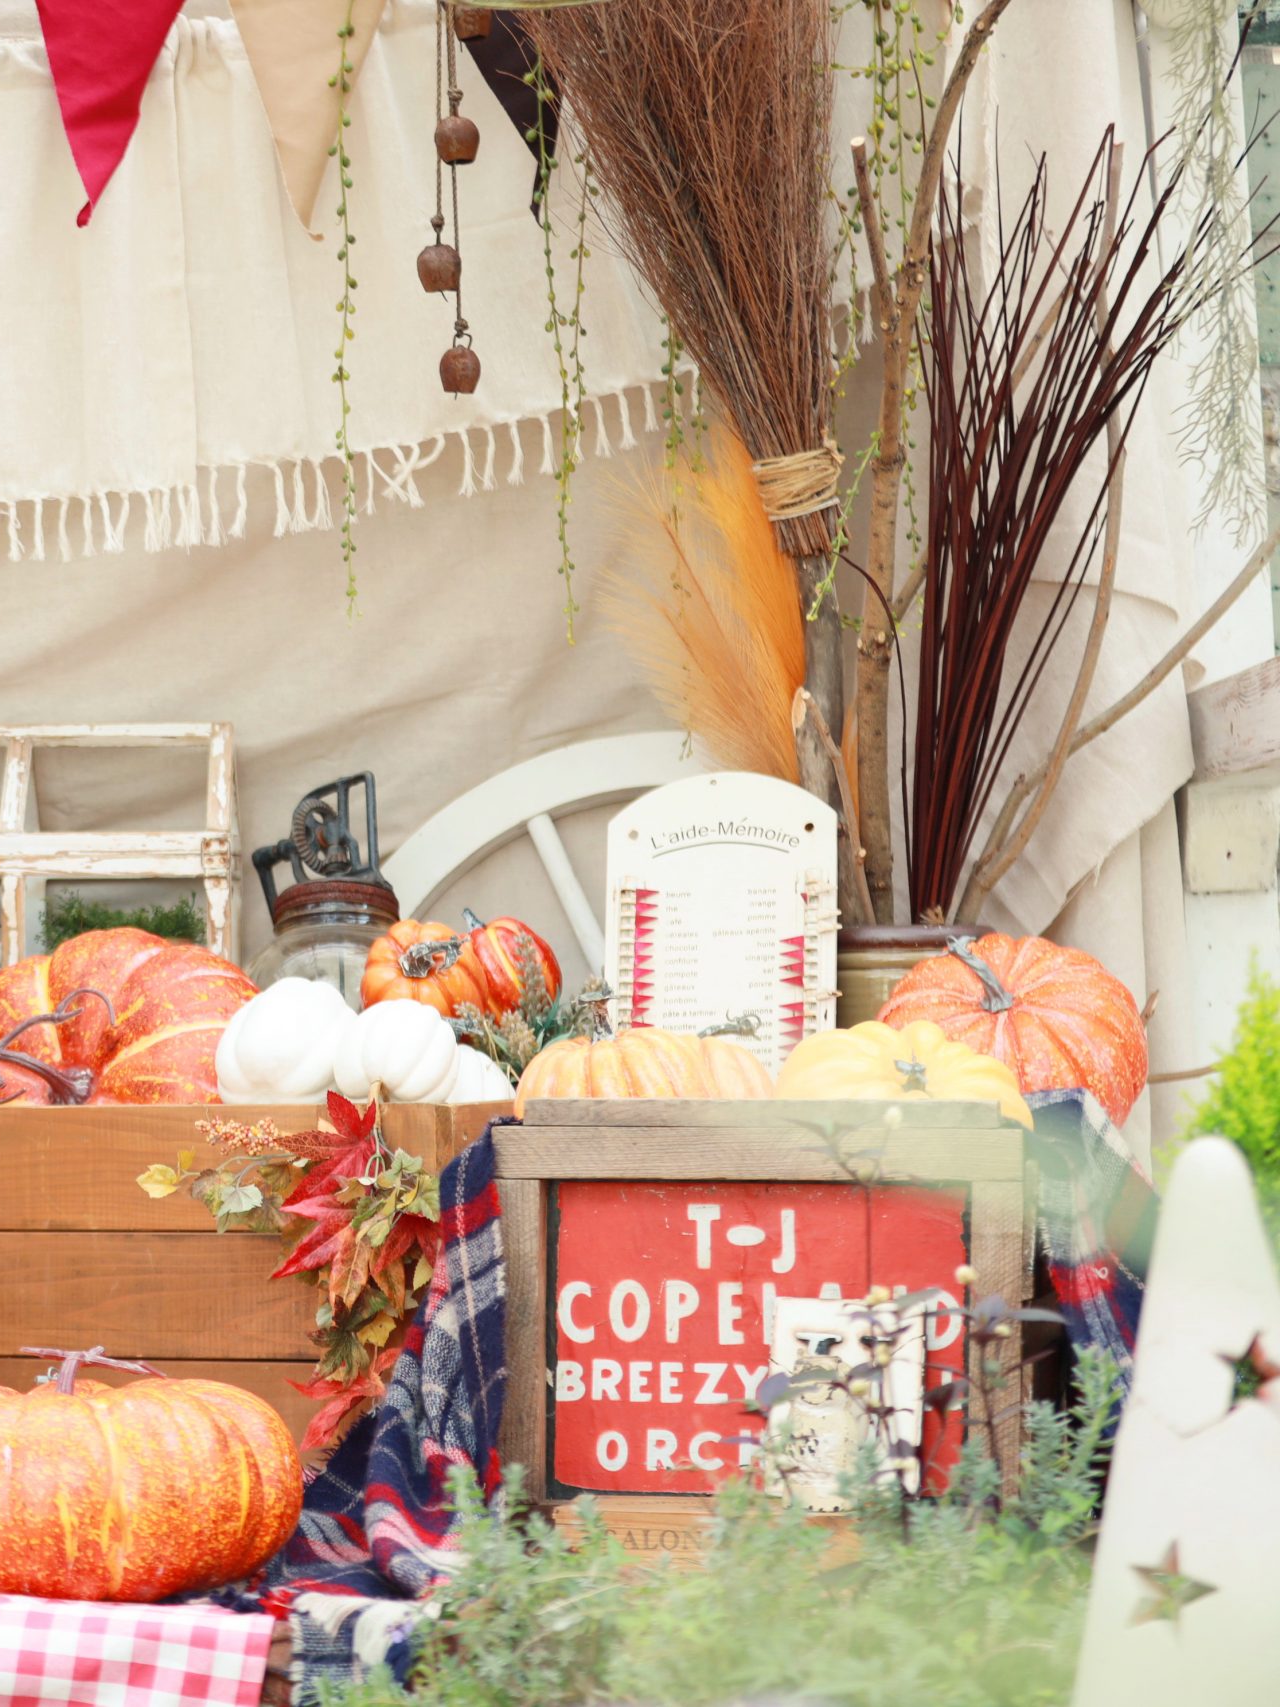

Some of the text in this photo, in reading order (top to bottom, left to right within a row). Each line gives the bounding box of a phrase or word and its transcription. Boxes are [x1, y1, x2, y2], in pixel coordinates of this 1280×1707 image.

[651, 817, 800, 850] L'aide-Mémoire
[558, 1279, 963, 1351] COPELD
[556, 1358, 769, 1404] BREEZY
